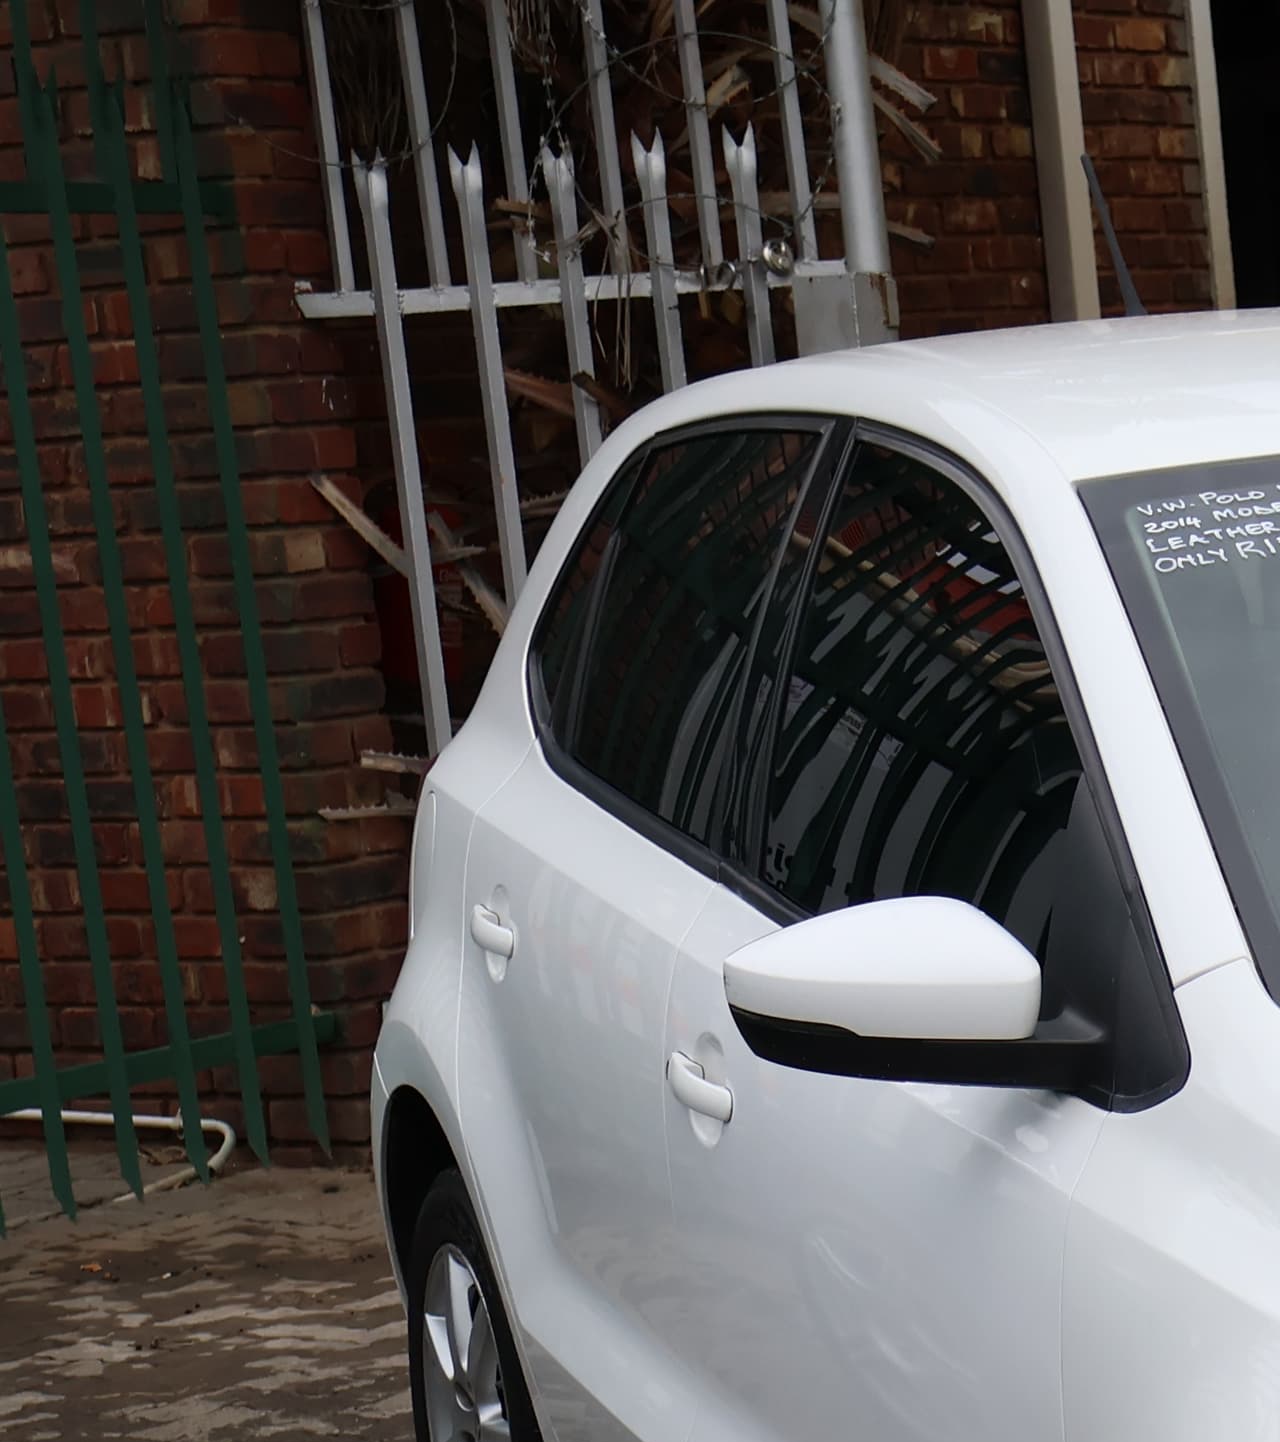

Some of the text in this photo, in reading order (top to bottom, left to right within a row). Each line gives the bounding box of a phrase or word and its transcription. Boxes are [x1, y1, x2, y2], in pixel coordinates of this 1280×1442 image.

[1143, 516, 1202, 533] 2014
[1146, 521, 1280, 553] LEATHER
[1154, 548, 1228, 573] ONLY
